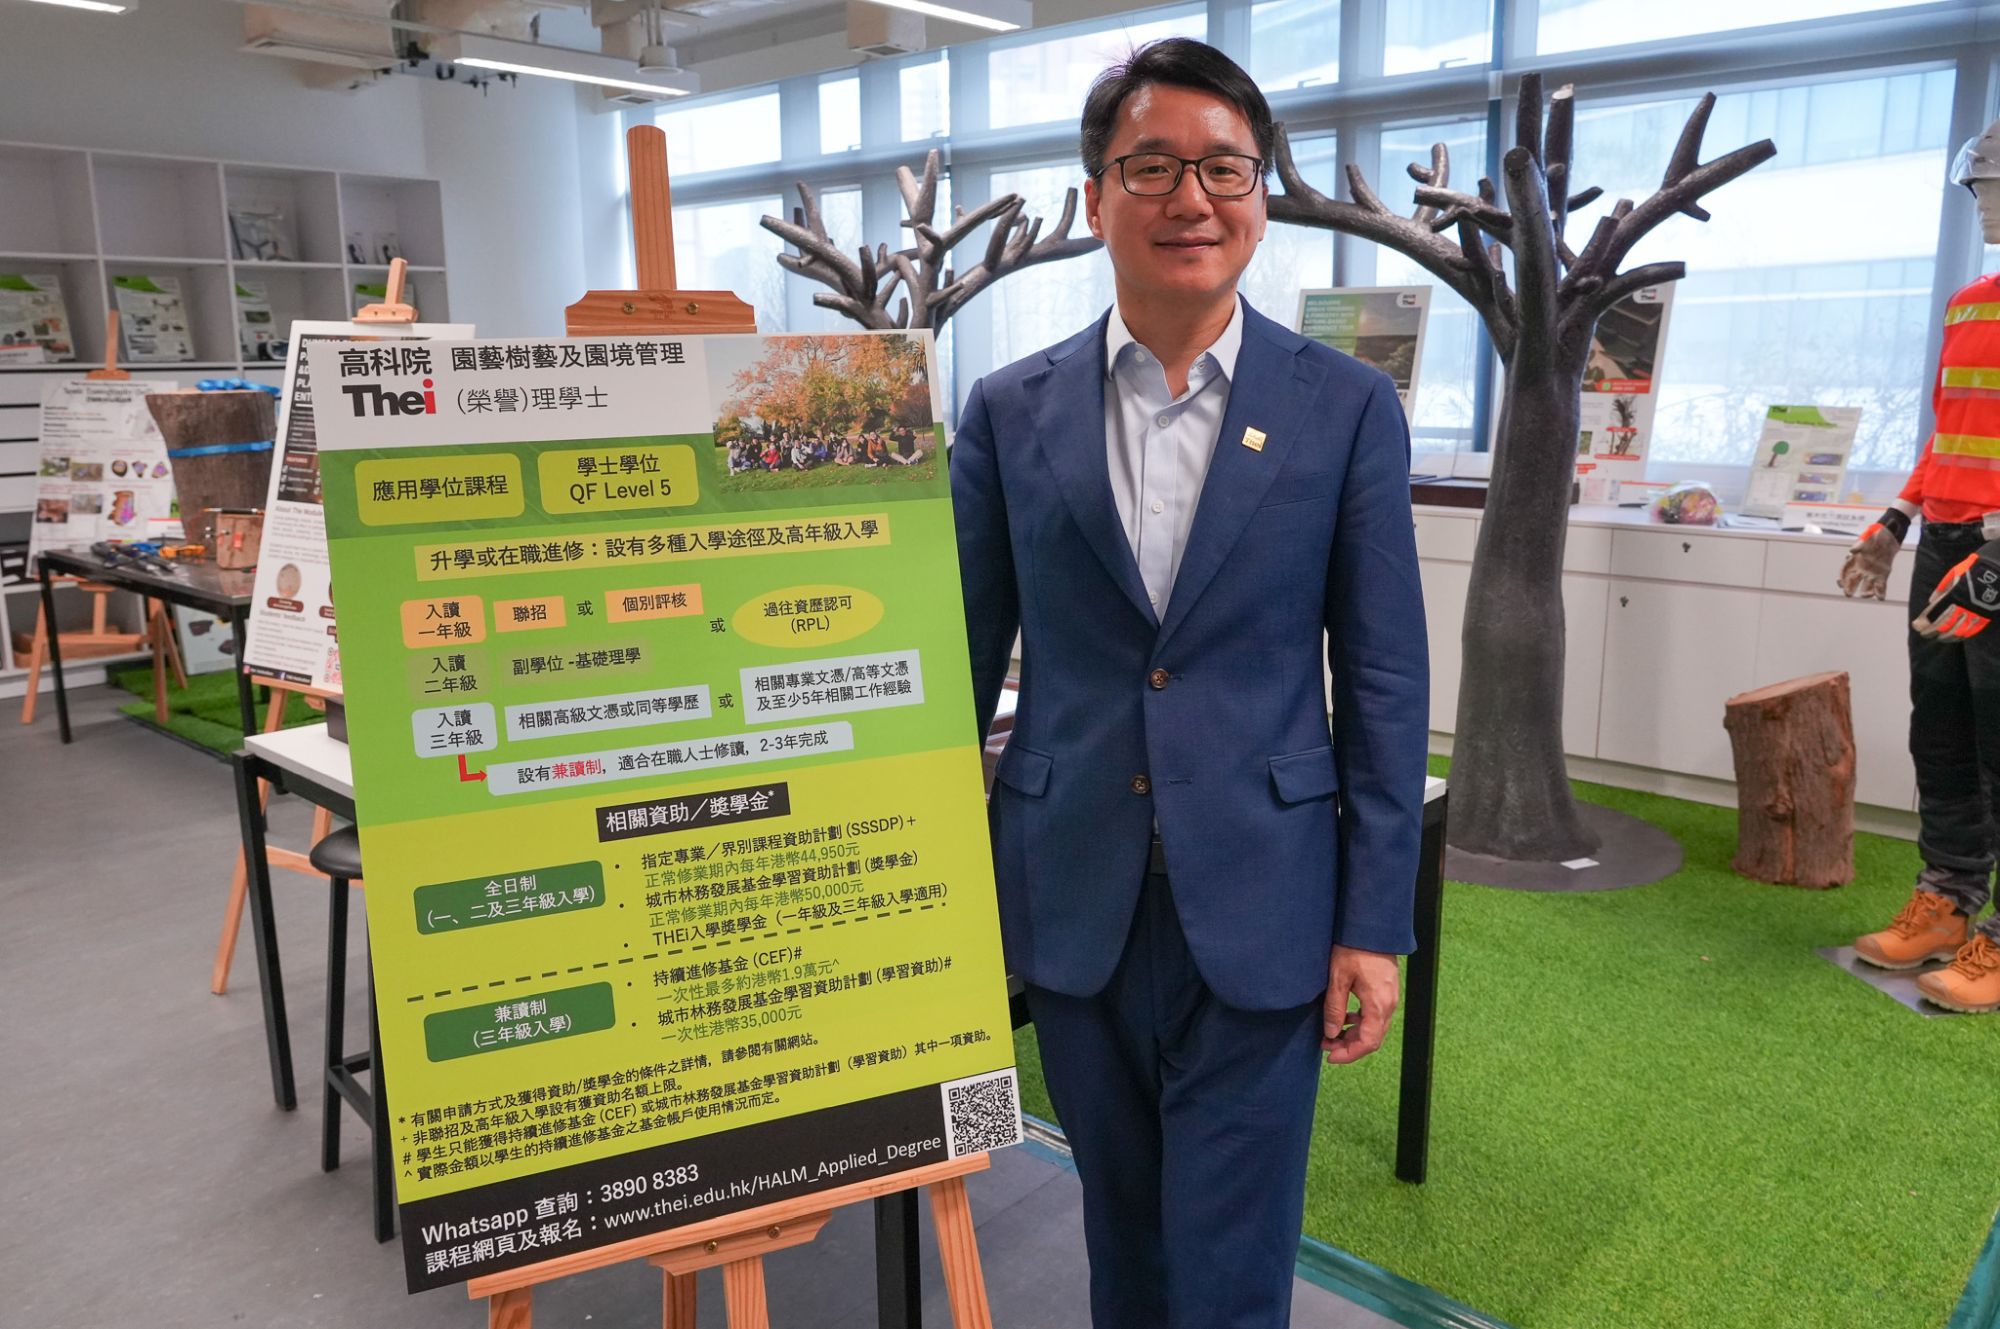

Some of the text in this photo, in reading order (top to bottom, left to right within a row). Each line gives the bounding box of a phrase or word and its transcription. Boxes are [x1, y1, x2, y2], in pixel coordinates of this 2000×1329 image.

[338, 346, 433, 378] 高科院
[451, 342, 685, 371] 園藝樹藝及園境管理
[342, 378, 436, 417] Thei
[456, 385, 609, 415] (榮譽)理學士
[577, 454, 661, 478] 學士學位
[373, 475, 509, 502] 應用學位課程
[569, 479, 672, 505] QF Level 5
[430, 519, 879, 571] 升學或在職進修：設有多種入學途徑及高年級入學
[426, 601, 462, 620] 入讀
[513, 604, 547, 622] 聯招
[576, 600, 593, 616] 或
[622, 592, 688, 613] 個別評核
[763, 595, 853, 618] 過往資歷認可
[418, 621, 472, 640] 一年級
[710, 617, 726, 633] 或
[791, 615, 830, 634] (RPL)
[431, 654, 466, 674] 入讀
[512, 655, 564, 676] 副學位
[755, 660, 909, 692] 相關專業文憑/高等文憑
[424, 674, 479, 694] 二年級
[757, 679, 912, 712] 及至少5年相關工作經驗
[518, 694, 700, 730] 相關高級文憑或同等學歷
[718, 692, 734, 709] 或
[437, 710, 473, 729] 入讀
[430, 729, 484, 750] 三年級
[484, 874, 537, 898] 全日制
[653, 955, 749, 988] 持續進修基金
[495, 998, 546, 1024] 兼讀制
[473, 1014, 571, 1049] (三年級入學)
[421, 1208, 529, 1245] Whatsapp
[652, 1164, 699, 1191] 8383
